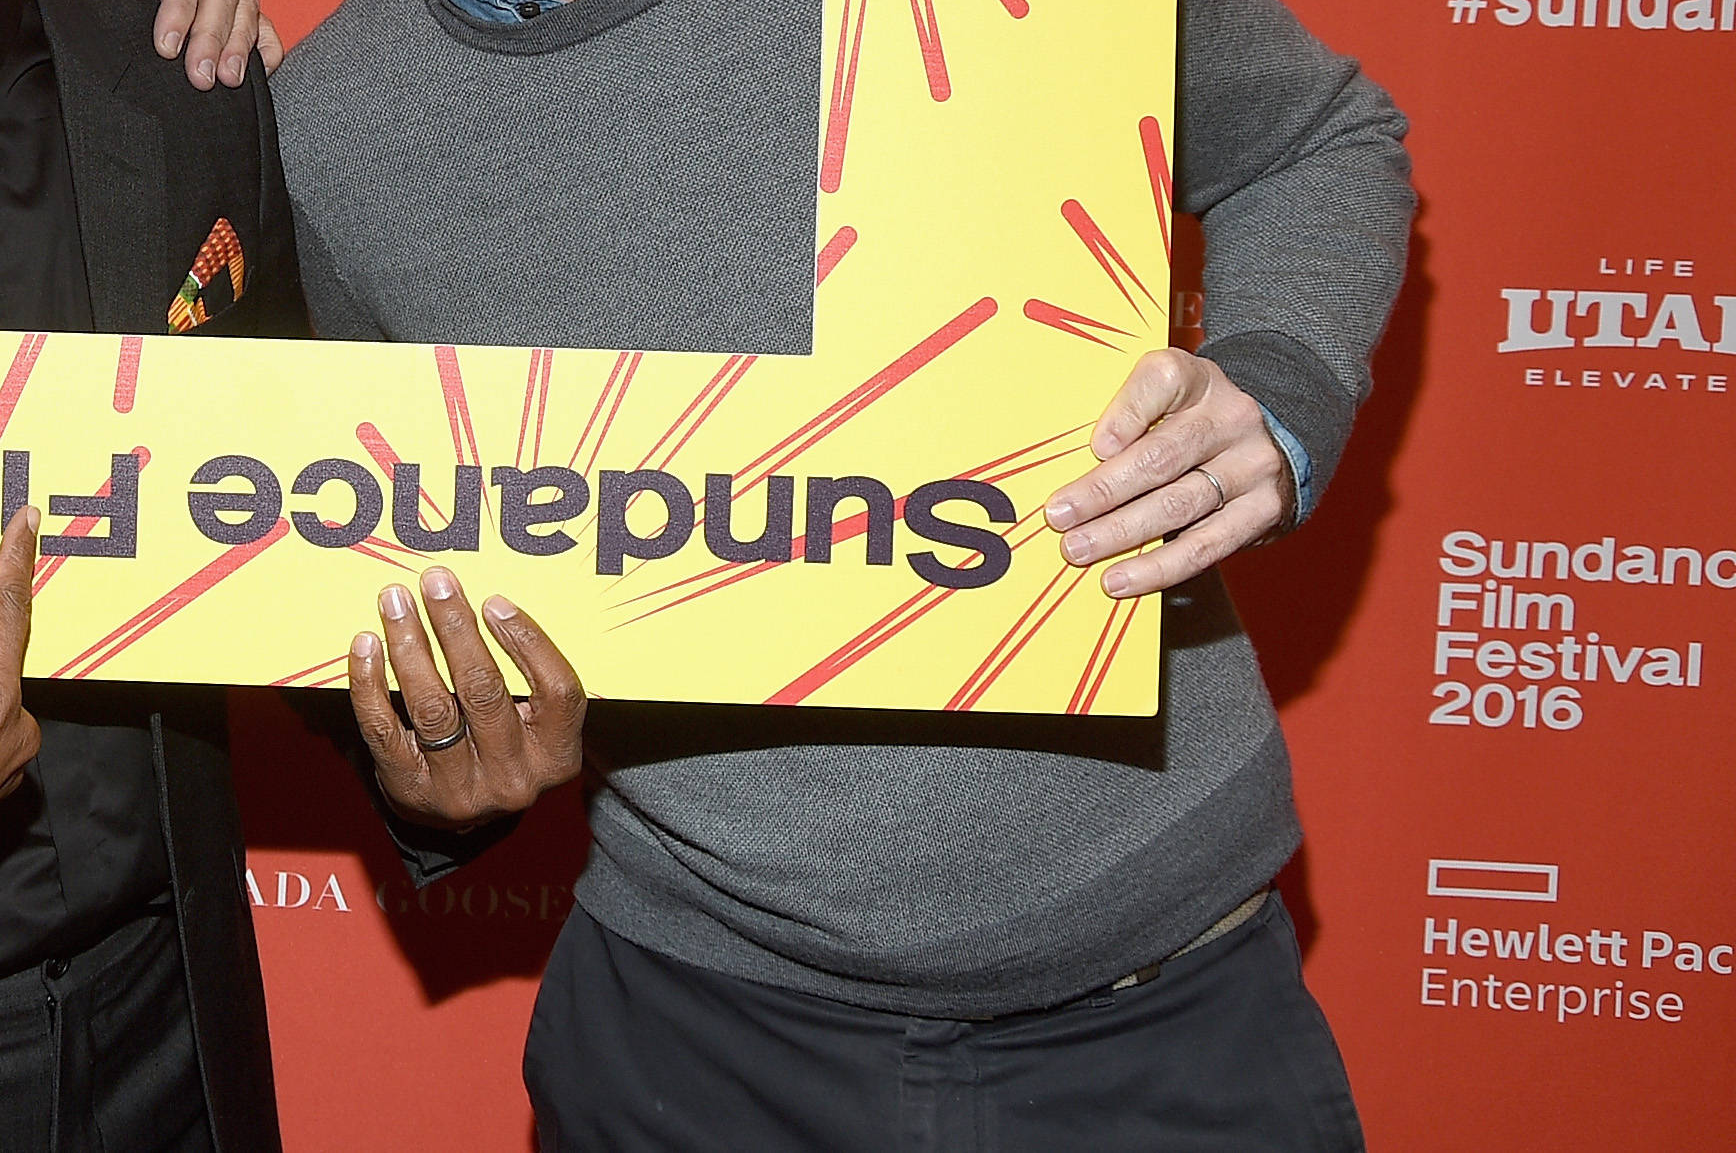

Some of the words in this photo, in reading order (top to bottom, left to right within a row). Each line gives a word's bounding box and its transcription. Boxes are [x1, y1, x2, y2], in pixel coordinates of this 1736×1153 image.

[1599, 258, 1694, 277] LIFE
[1524, 368, 1728, 392] ELEVATE
[186, 454, 1020, 590] Sundance
[1438, 530, 1736, 589] Sundanc
[1437, 580, 1576, 632] Film
[1433, 631, 1703, 687] Festival
[1429, 681, 1585, 731] 2016
[1422, 916, 1629, 967] Hewlett
[1420, 967, 1684, 1023] Enterprise
